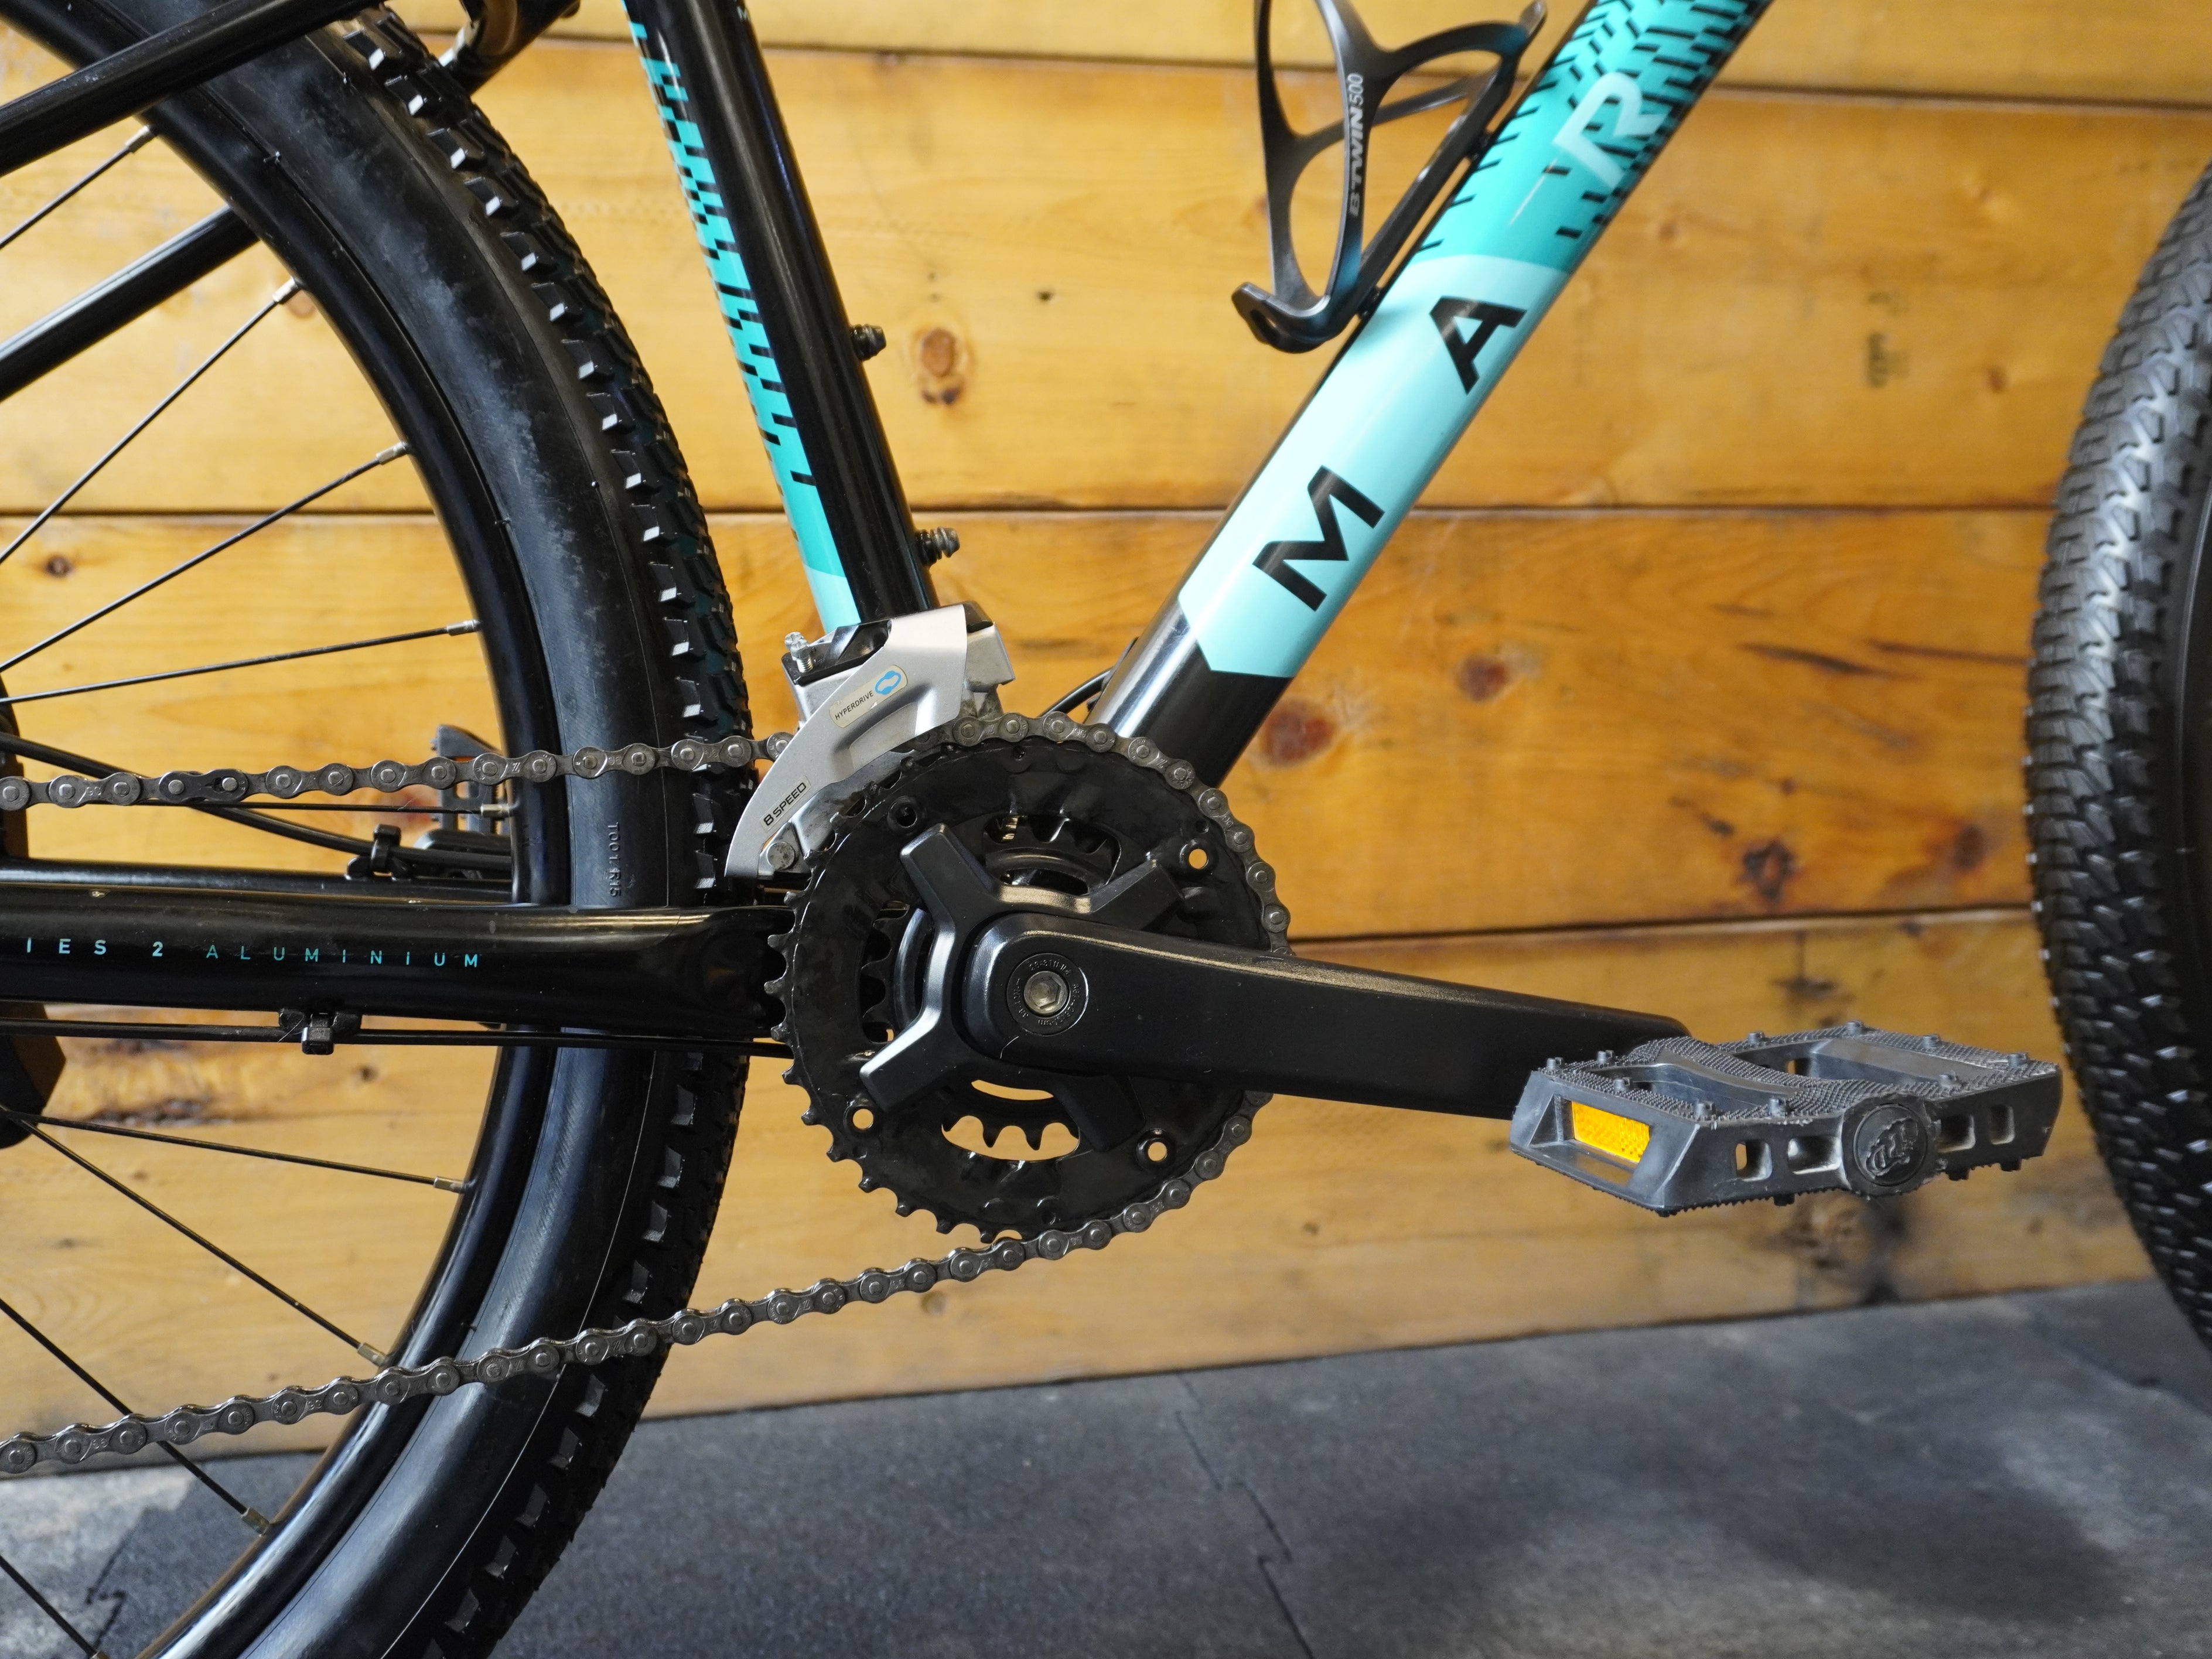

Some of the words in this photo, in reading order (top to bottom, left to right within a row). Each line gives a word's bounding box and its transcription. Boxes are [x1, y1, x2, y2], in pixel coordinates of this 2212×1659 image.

[1347, 72, 1364, 107] 500
[834, 689, 874, 721] HYPERDRIVE
[763, 814, 774, 827] 8
[772, 781, 807, 817] SPEED
[151, 941, 164, 957] 2
[206, 944, 479, 968] ALUMINIUM
